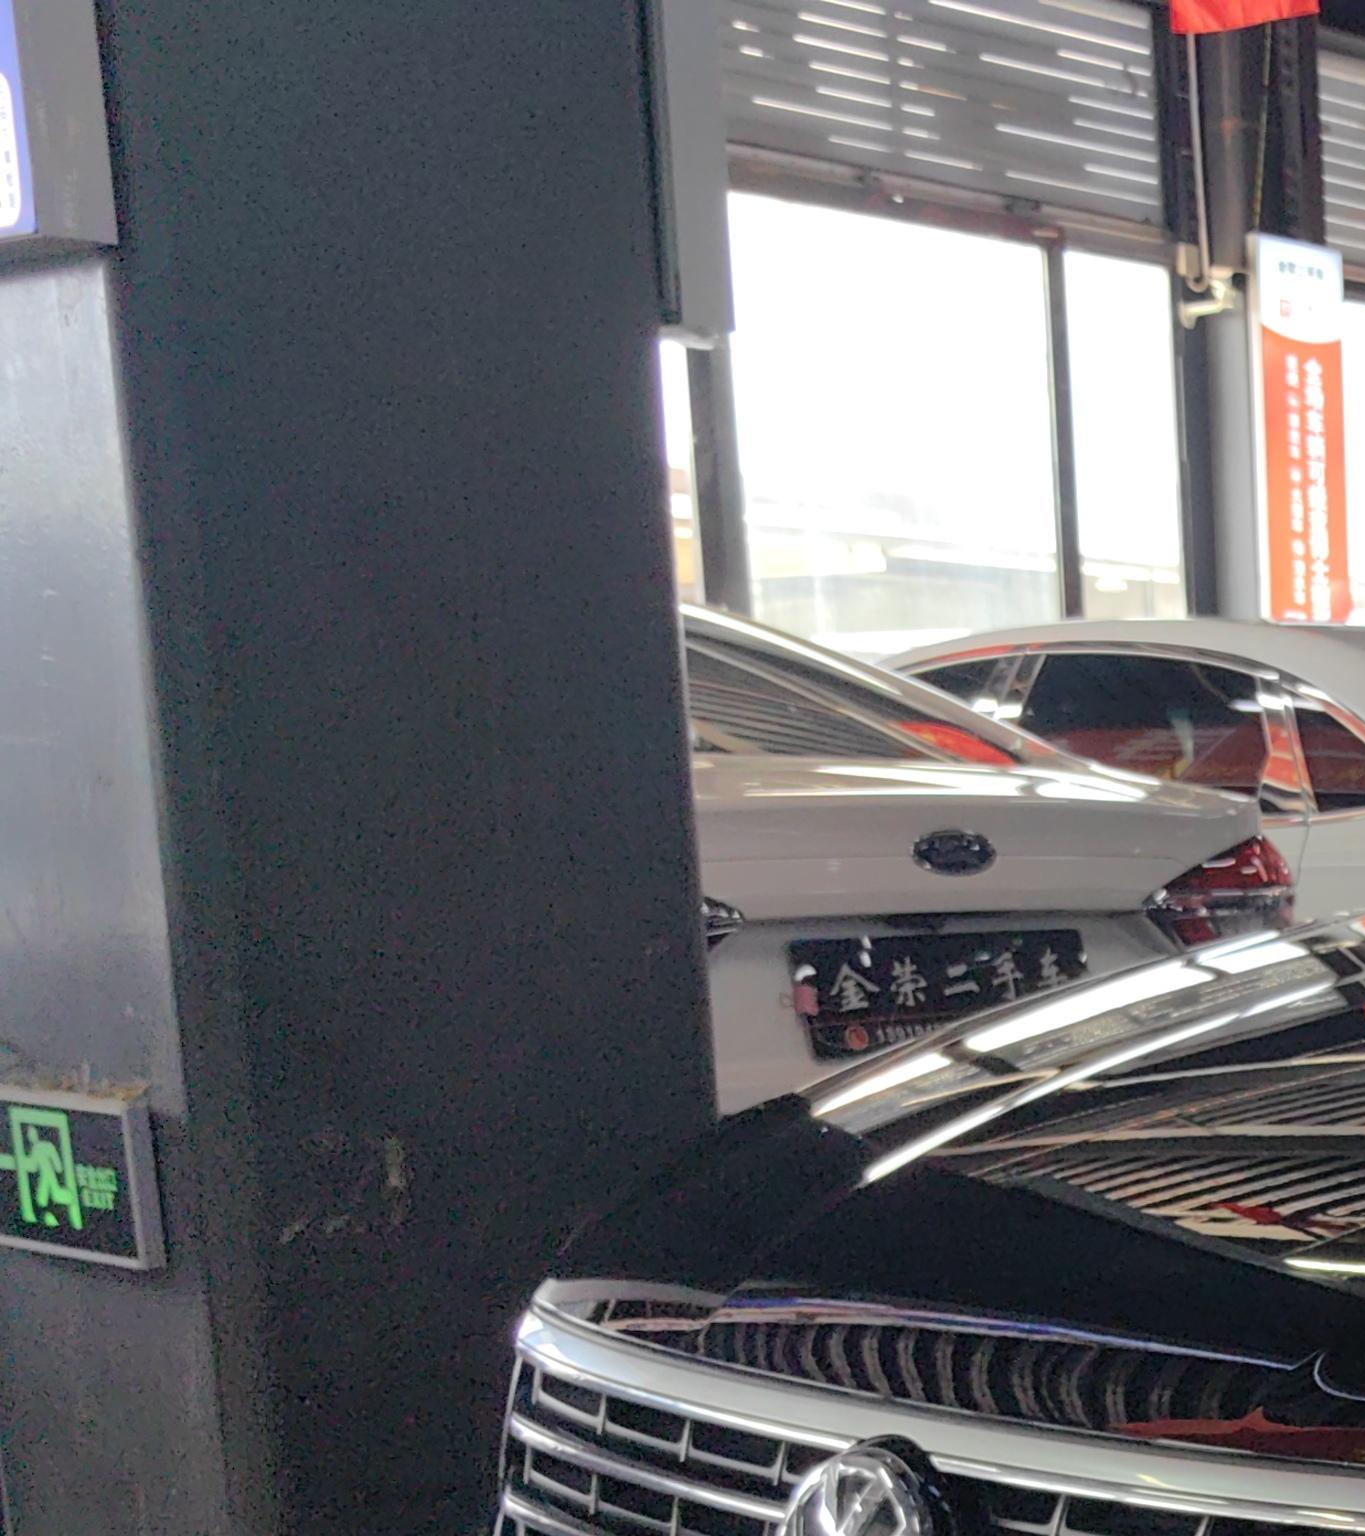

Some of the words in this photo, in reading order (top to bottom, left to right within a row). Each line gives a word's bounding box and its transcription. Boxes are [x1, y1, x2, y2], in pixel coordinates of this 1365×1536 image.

[829, 946, 1068, 1012] 金荣二手车
